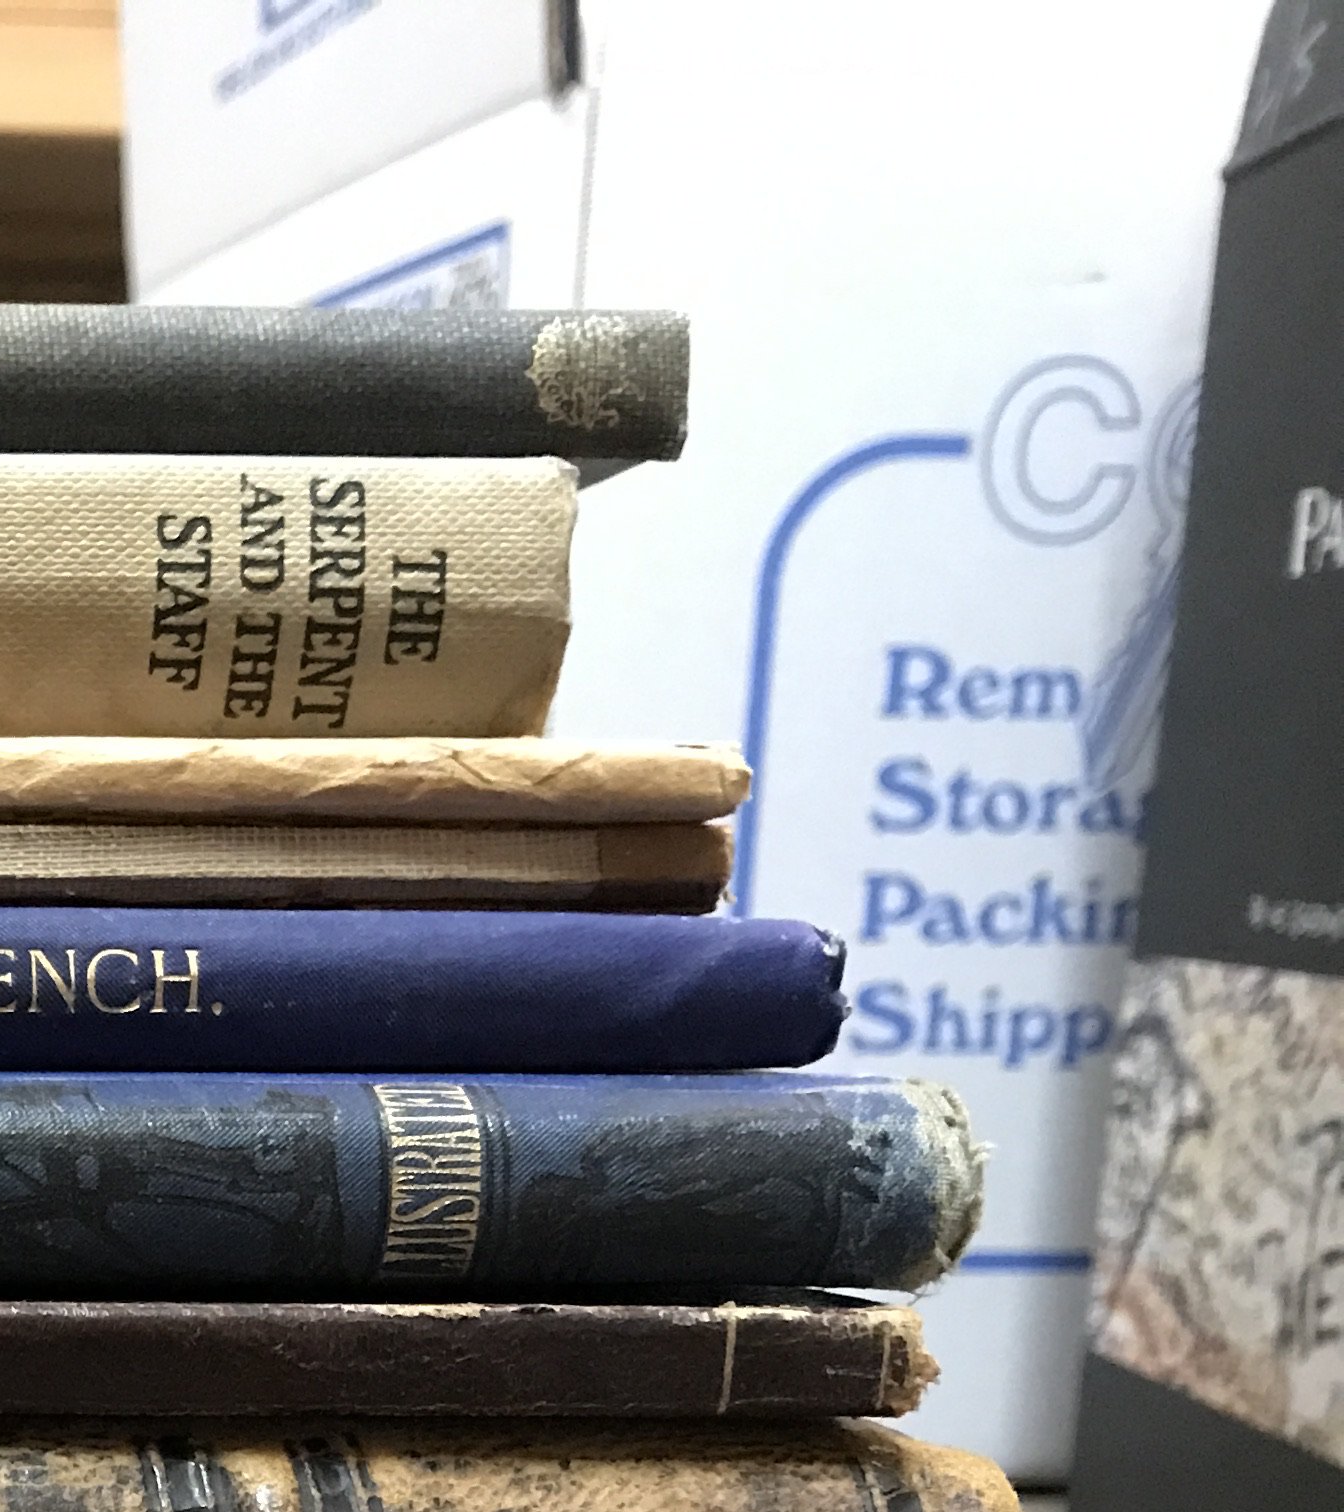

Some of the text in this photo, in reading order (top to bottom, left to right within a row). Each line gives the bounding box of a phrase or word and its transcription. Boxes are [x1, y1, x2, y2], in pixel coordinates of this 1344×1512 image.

[149, 513, 212, 692] STAFF
[223, 473, 285, 719] AND THE
[291, 475, 367, 729] SERPENT
[383, 549, 447, 667] THE
[373, 1082, 481, 1280] LLUSTRATED
